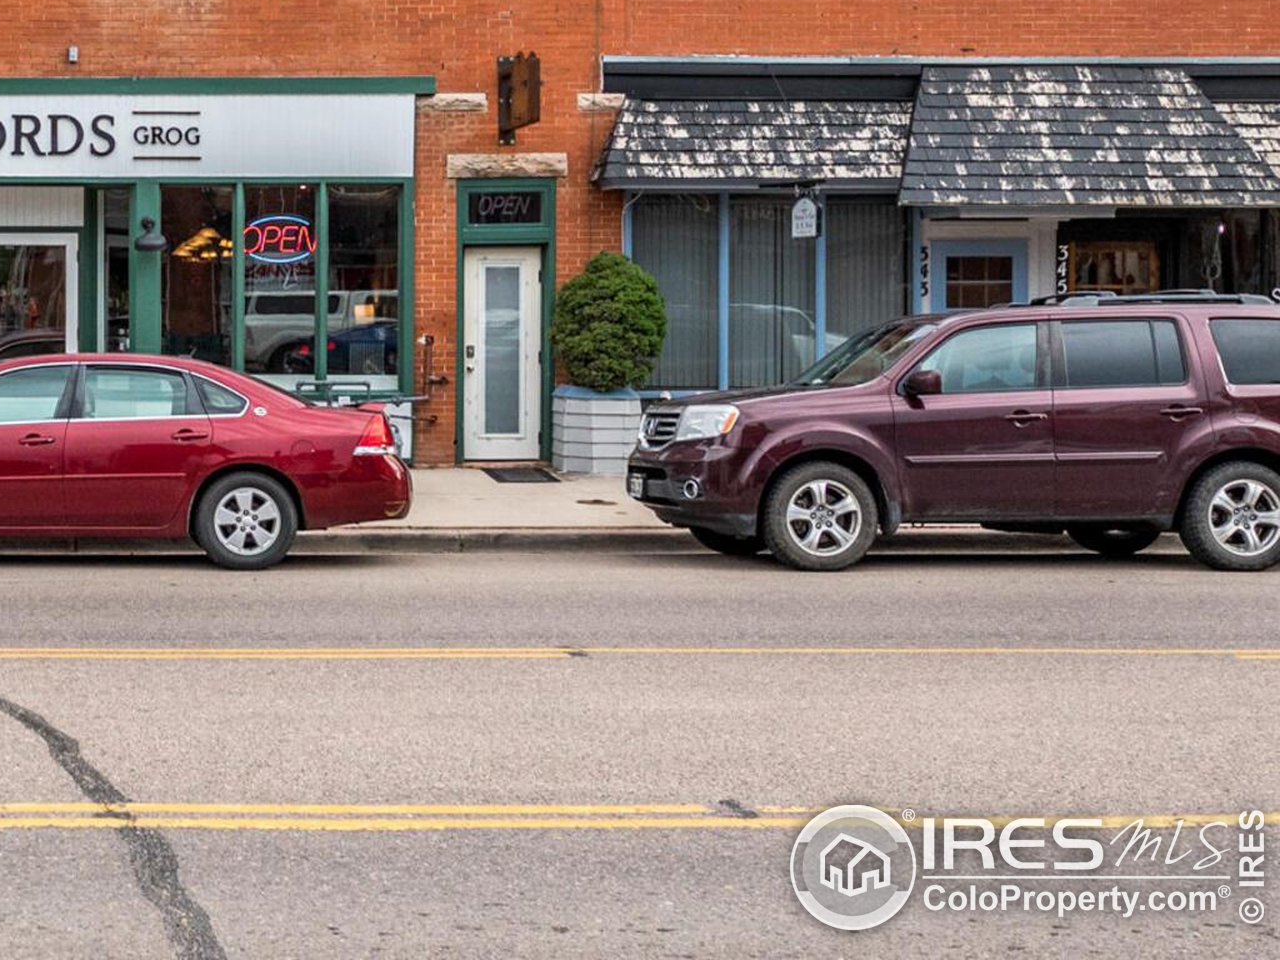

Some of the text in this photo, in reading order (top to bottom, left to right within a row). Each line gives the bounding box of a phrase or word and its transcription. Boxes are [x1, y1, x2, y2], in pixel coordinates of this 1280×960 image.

[132, 126, 201, 146] GROG
[478, 195, 531, 216] OPEN
[243, 225, 318, 254] OPEN
[1057, 244, 1069, 295] 345
